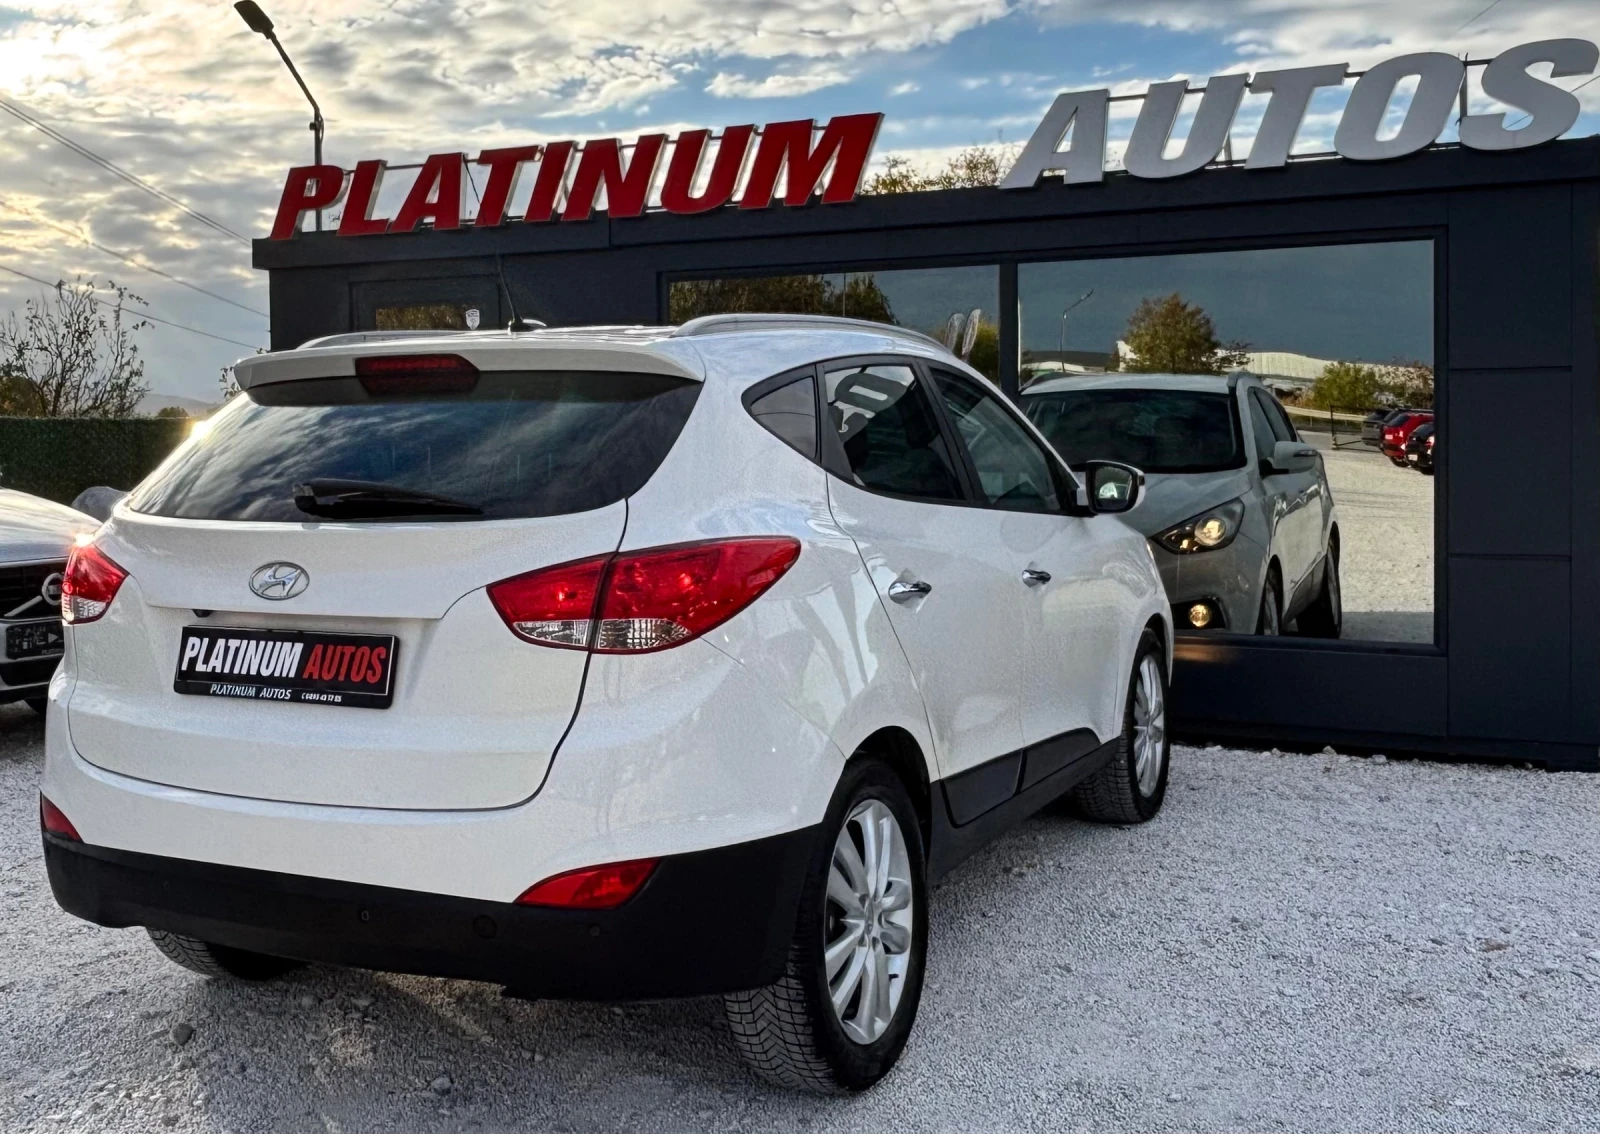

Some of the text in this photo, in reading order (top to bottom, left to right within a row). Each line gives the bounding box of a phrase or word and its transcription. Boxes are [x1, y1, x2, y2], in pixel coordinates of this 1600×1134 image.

[270, 38, 1600, 240] PLATINUM AUTOS
[181, 636, 386, 684] PLATINUM AUTOS
[210, 683, 256, 697] PLATINUM
[259, 687, 292, 700] AUTOS
